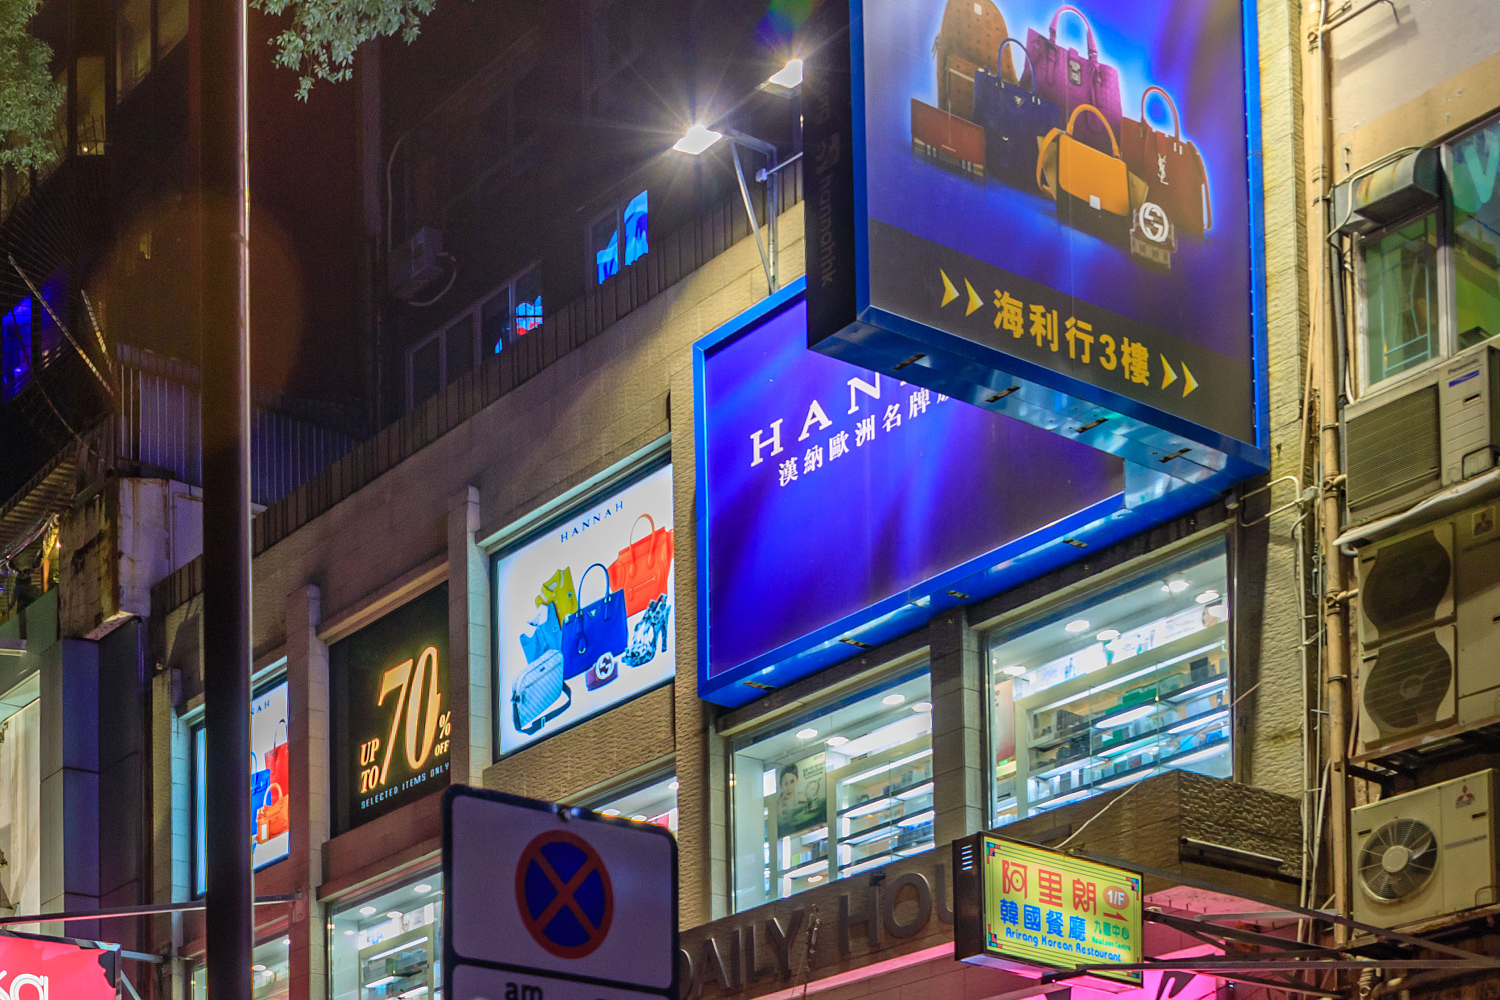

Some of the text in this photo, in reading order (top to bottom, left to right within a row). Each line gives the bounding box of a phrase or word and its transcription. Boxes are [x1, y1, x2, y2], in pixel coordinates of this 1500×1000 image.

[993, 289, 1150, 386] 海利行3樓
[750, 372, 906, 467] HAN
[560, 500, 625, 543] HANNAH
[360, 738, 380, 766] UP
[434, 740, 449, 756] OFF
[360, 766, 380, 794] TO
[361, 762, 450, 809] SELECTED ITEMS ONLY
[1002, 860, 1097, 916] 阿里朗
[1107, 890, 1125, 906] 1/F
[1000, 898, 1087, 942] 韓國餐廳
[1005, 927, 1121, 962] Arirang Korean Restaurant
